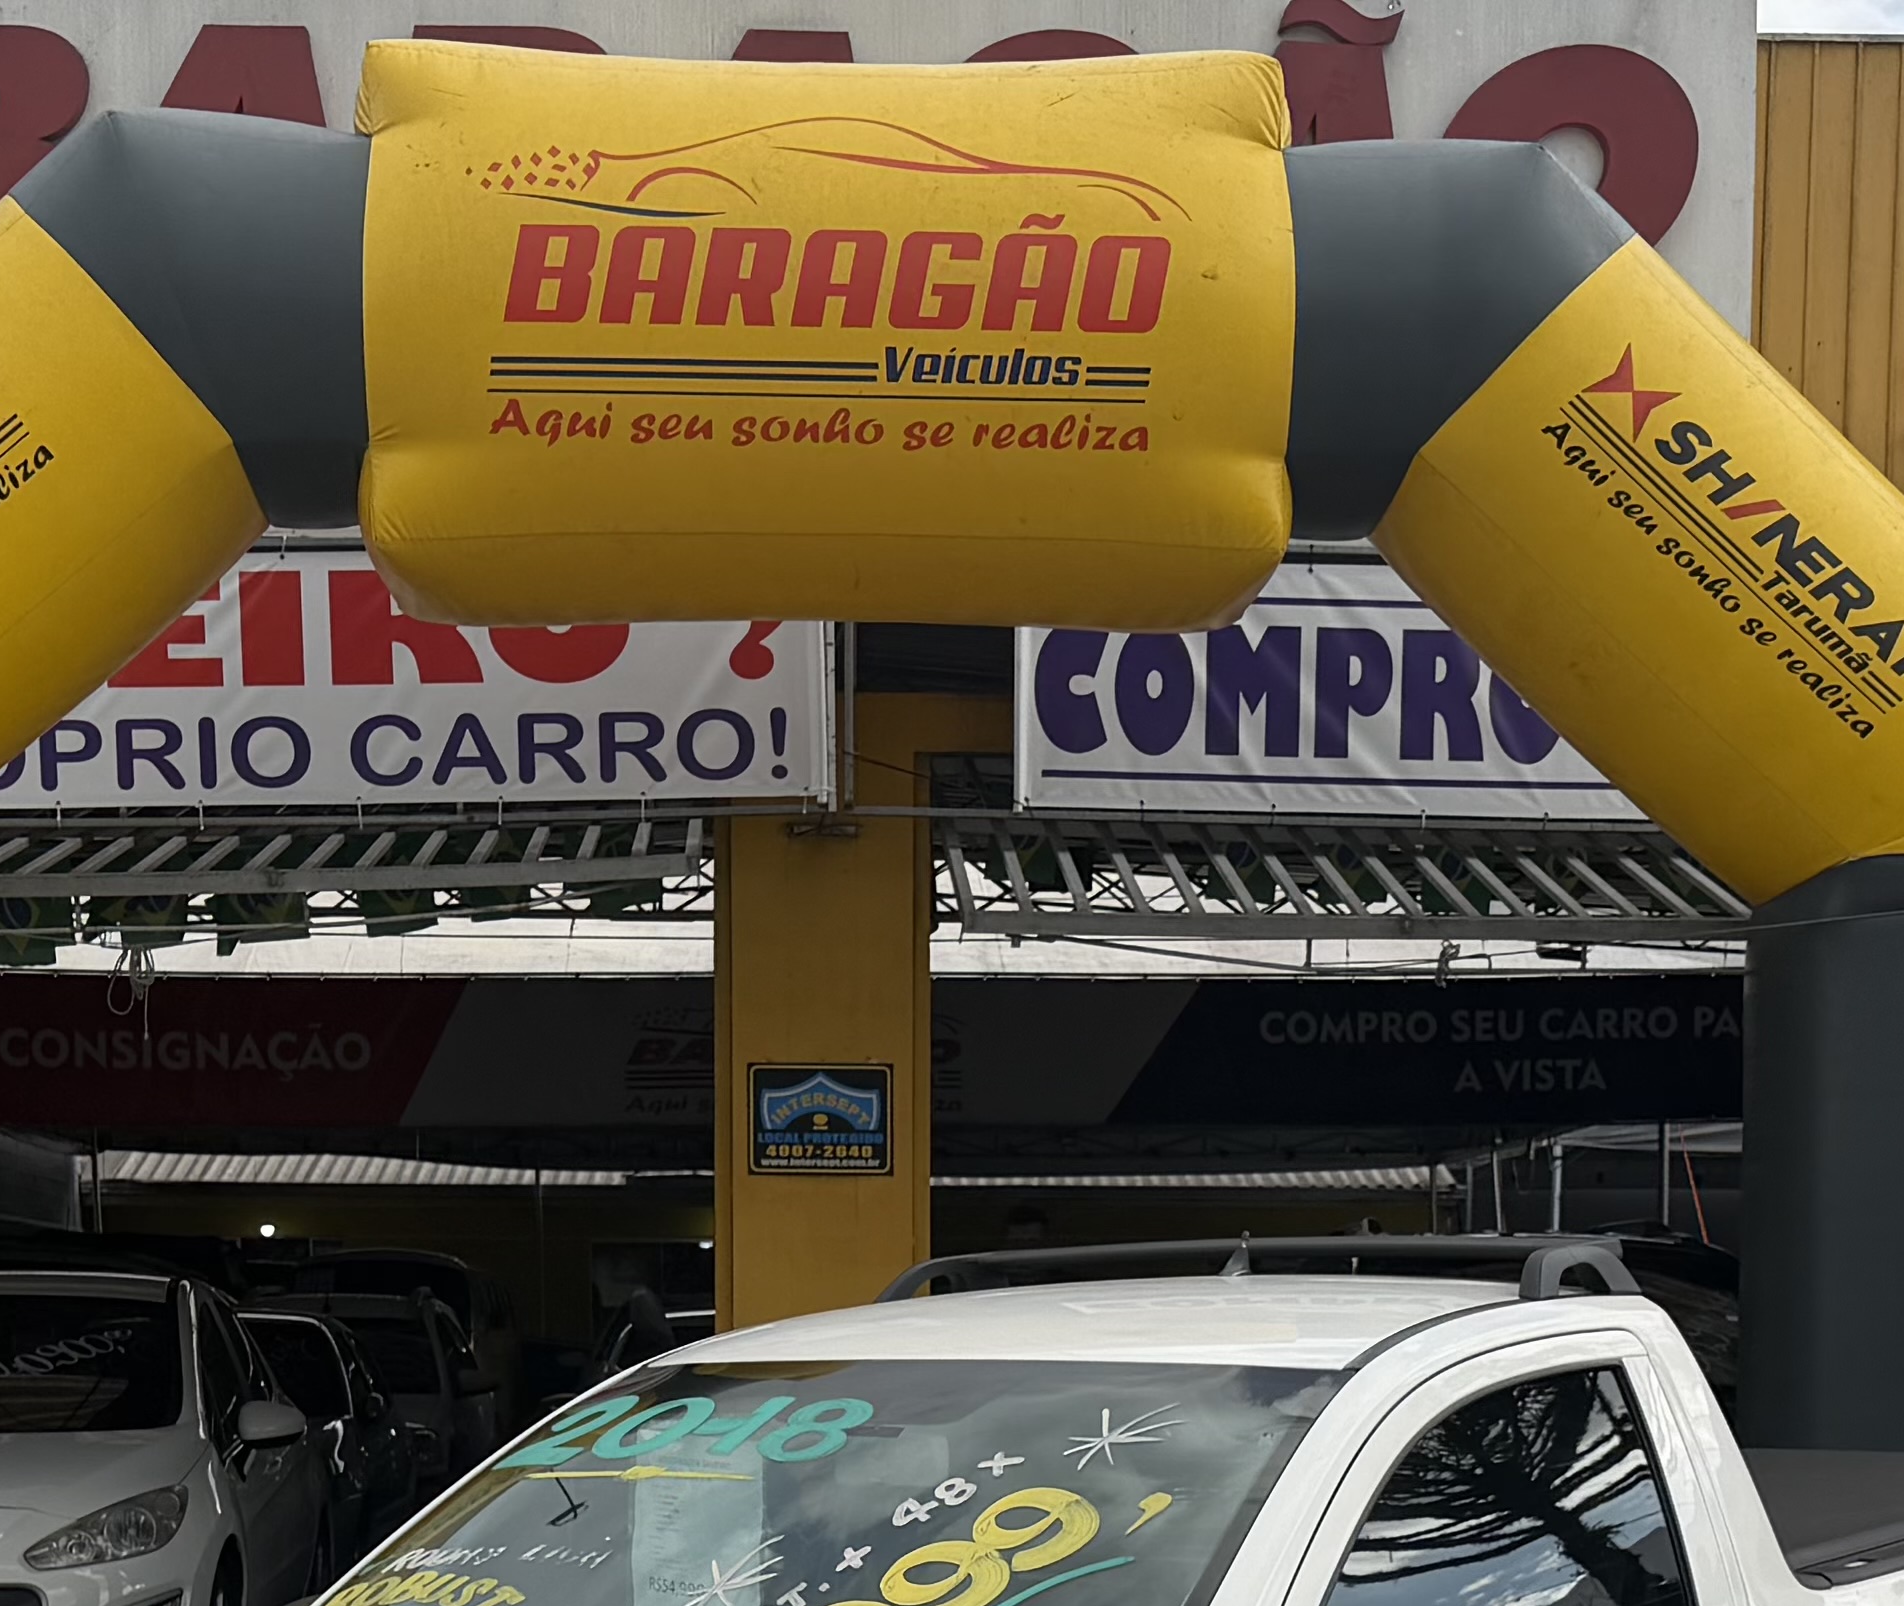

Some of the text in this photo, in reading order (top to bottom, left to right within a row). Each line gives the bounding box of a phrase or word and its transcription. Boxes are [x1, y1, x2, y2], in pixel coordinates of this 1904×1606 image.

[504, 214, 1172, 334] BARAGÃO
[883, 346, 1081, 388] Veículos
[489, 399, 1149, 453] Aqui seu sonho se realiza
[1541, 422, 1875, 739] Aqui seu sonho se realiza
[1761, 570, 1871, 675] Tarumã
[349, 705, 789, 788] CARRO!
[1260, 1010, 1438, 1046] COMPRO
[1450, 1008, 1526, 1043] SEU
[1538, 1005, 1677, 1042] CARRO
[1454, 1056, 1608, 1092] A VISTA
[770, 1091, 872, 1125] INTERSEPT
[757, 1132, 800, 1145] LOCAL
[497, 1392, 874, 1470] 2018
